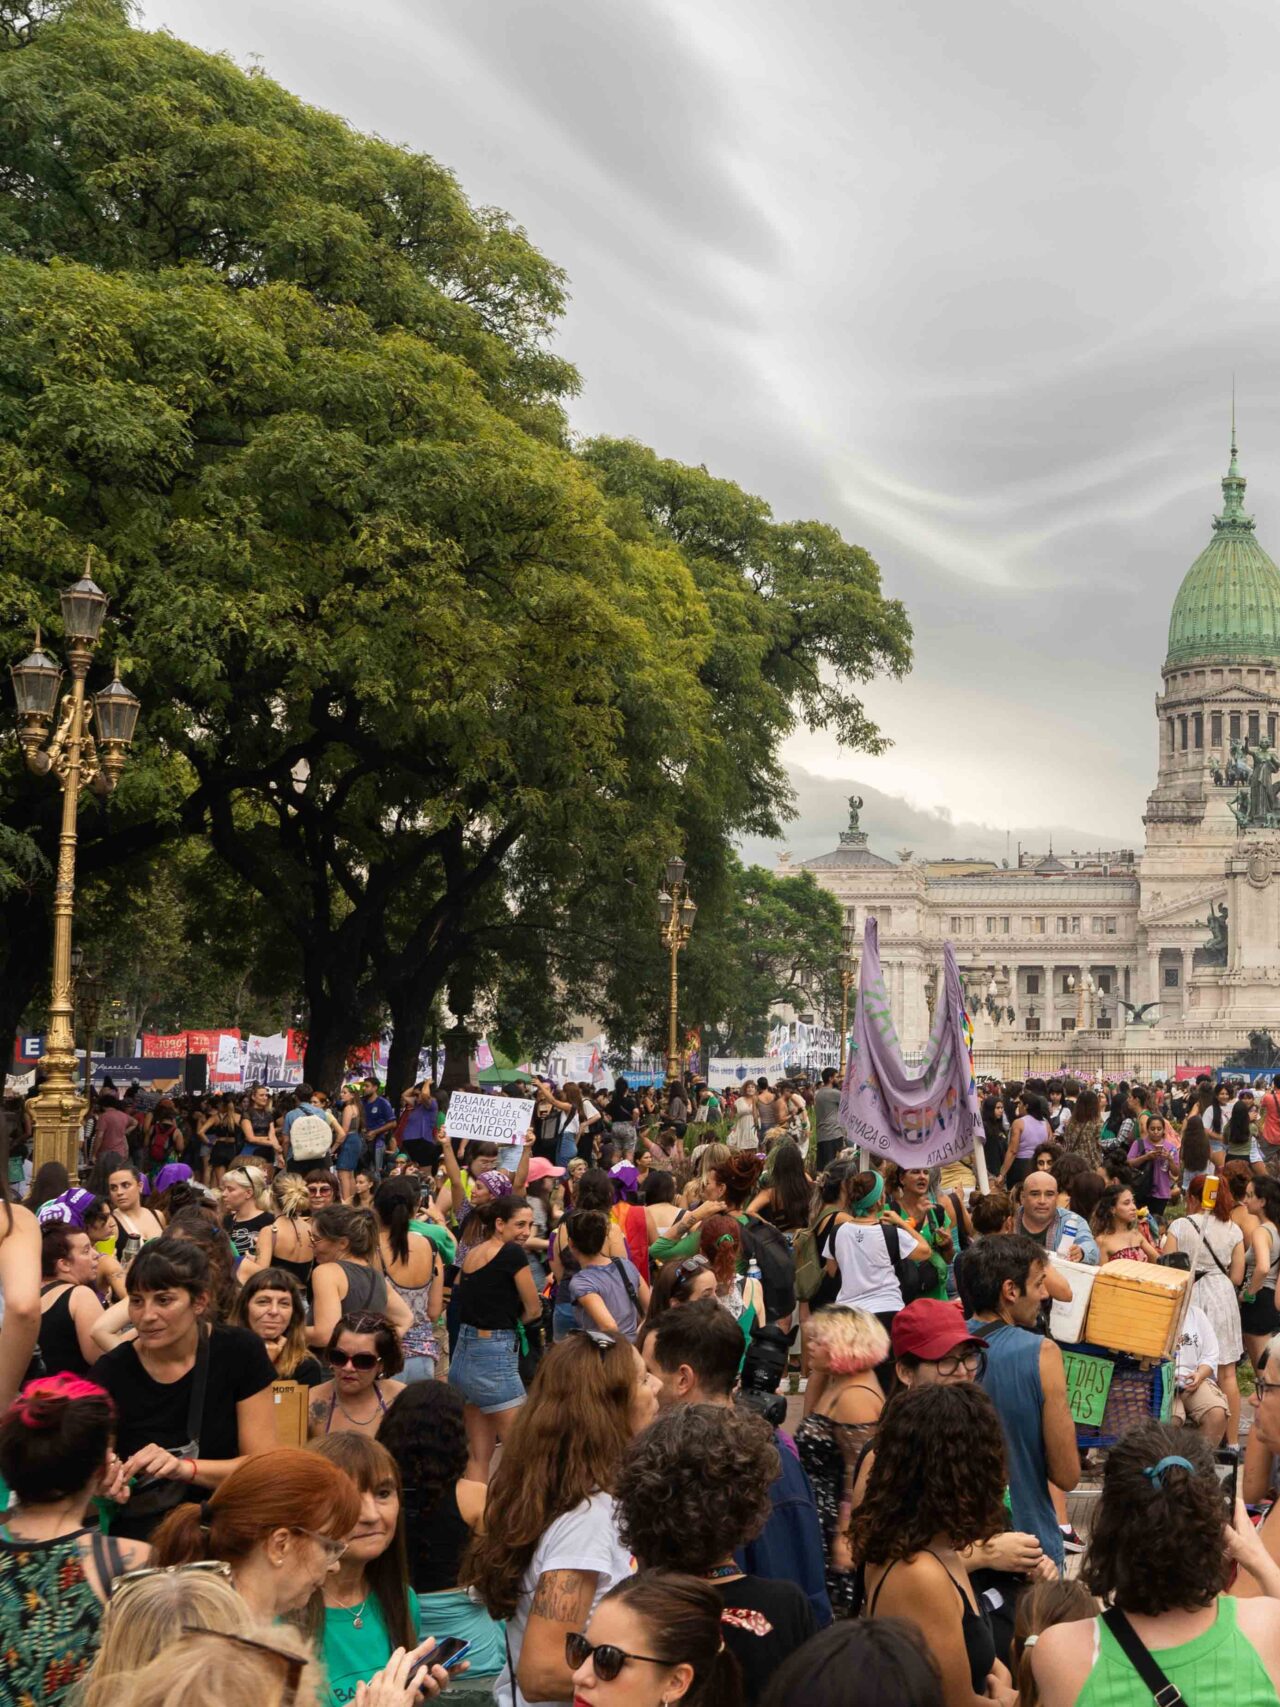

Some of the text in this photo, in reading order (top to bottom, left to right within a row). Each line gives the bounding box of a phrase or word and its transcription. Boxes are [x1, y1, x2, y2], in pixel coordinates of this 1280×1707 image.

[25, 1038, 40, 1055] E
[454, 1095, 496, 1108] BAJAME
[447, 1112, 496, 1125] MACHITO
[449, 1103, 521, 1119] PERSIANA QUE EL
[450, 1122, 513, 1138] CON MIEDO
[1065, 1356, 1109, 1393] IDAS
[1067, 1389, 1094, 1419] AS
